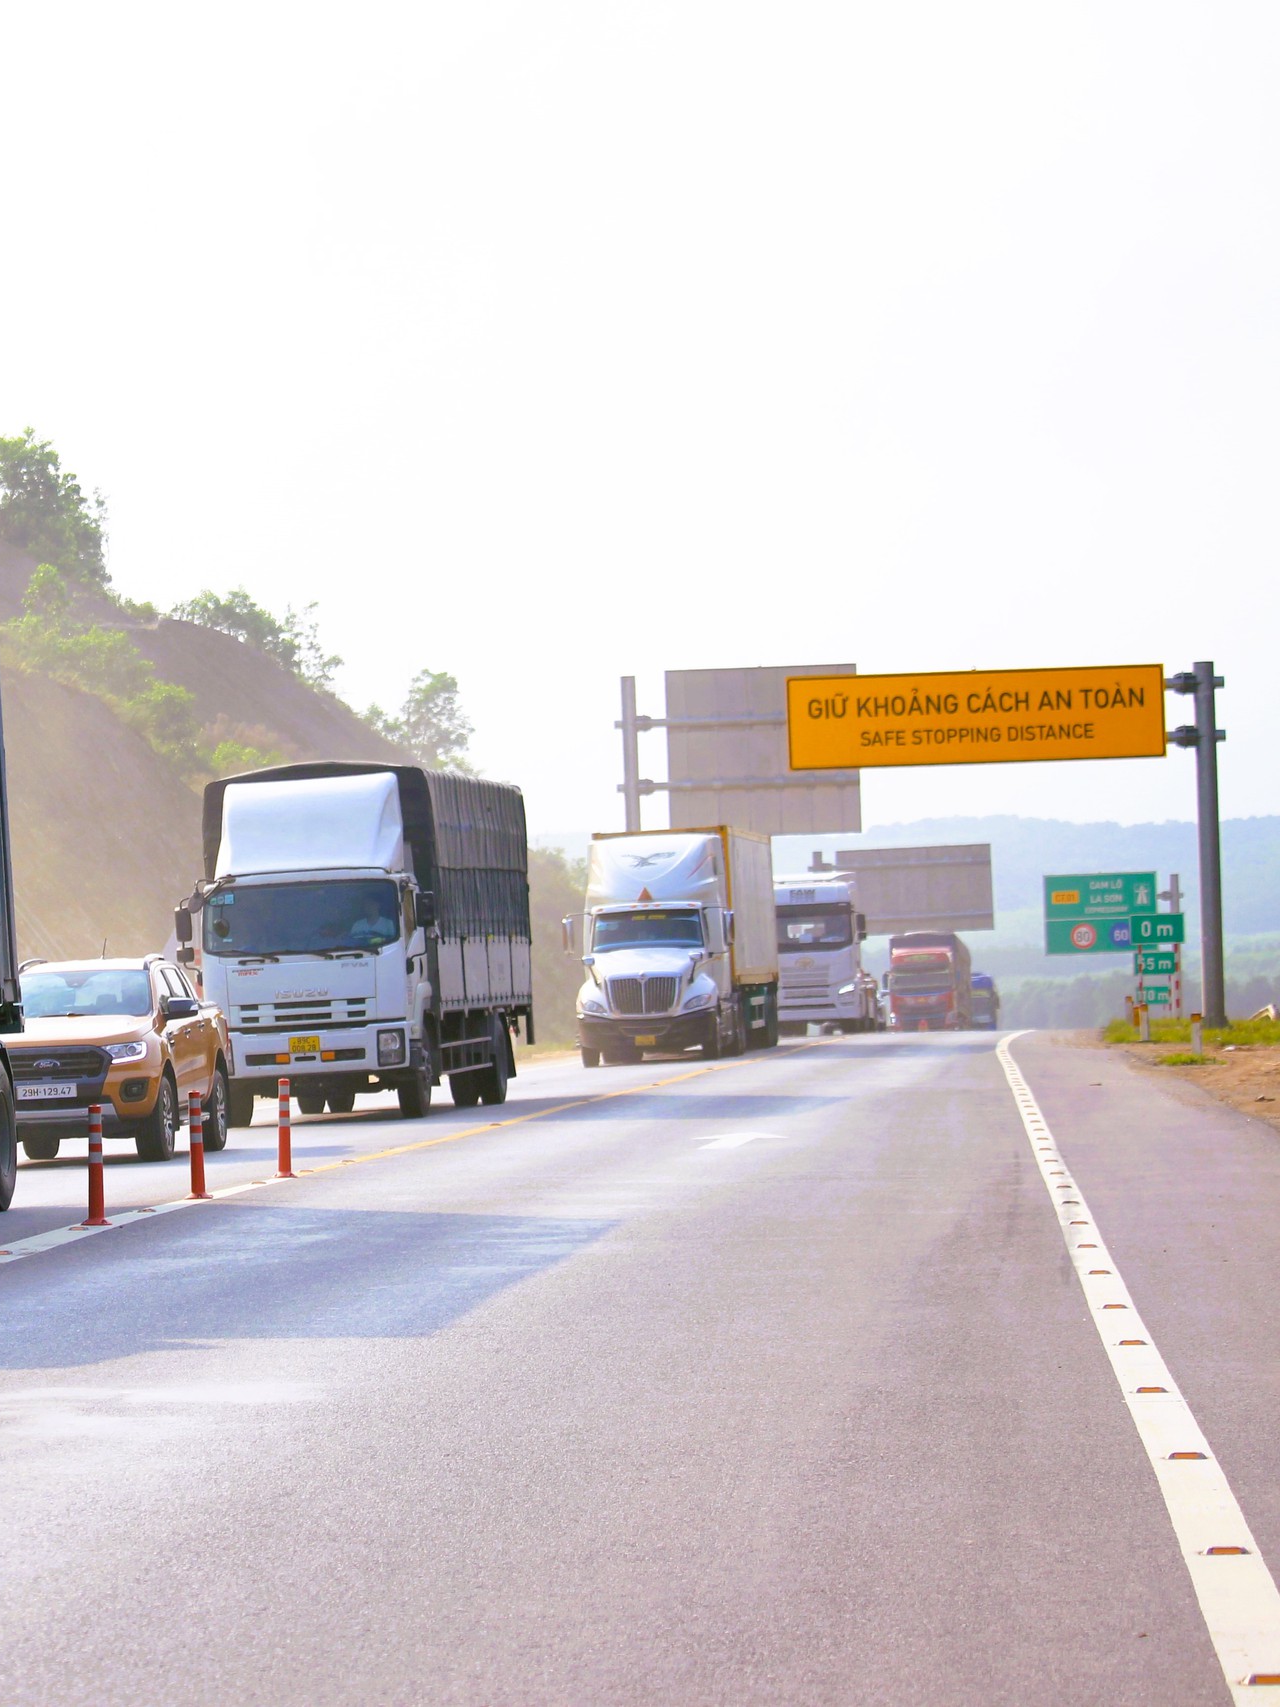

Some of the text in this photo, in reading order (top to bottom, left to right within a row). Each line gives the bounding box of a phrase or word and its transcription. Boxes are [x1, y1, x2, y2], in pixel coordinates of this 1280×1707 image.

[807, 683, 1145, 719] GIỮ KHOẢNG CÁCH AN TOÀN
[860, 723, 1095, 747] SAFE STOPPING DISTANCE
[1141, 921, 1173, 937] 0 m
[1076, 931, 1091, 942] 80
[1113, 930, 1128, 941] 60
[1158, 959, 1172, 970] m
[275, 987, 329, 998] ISUZU
